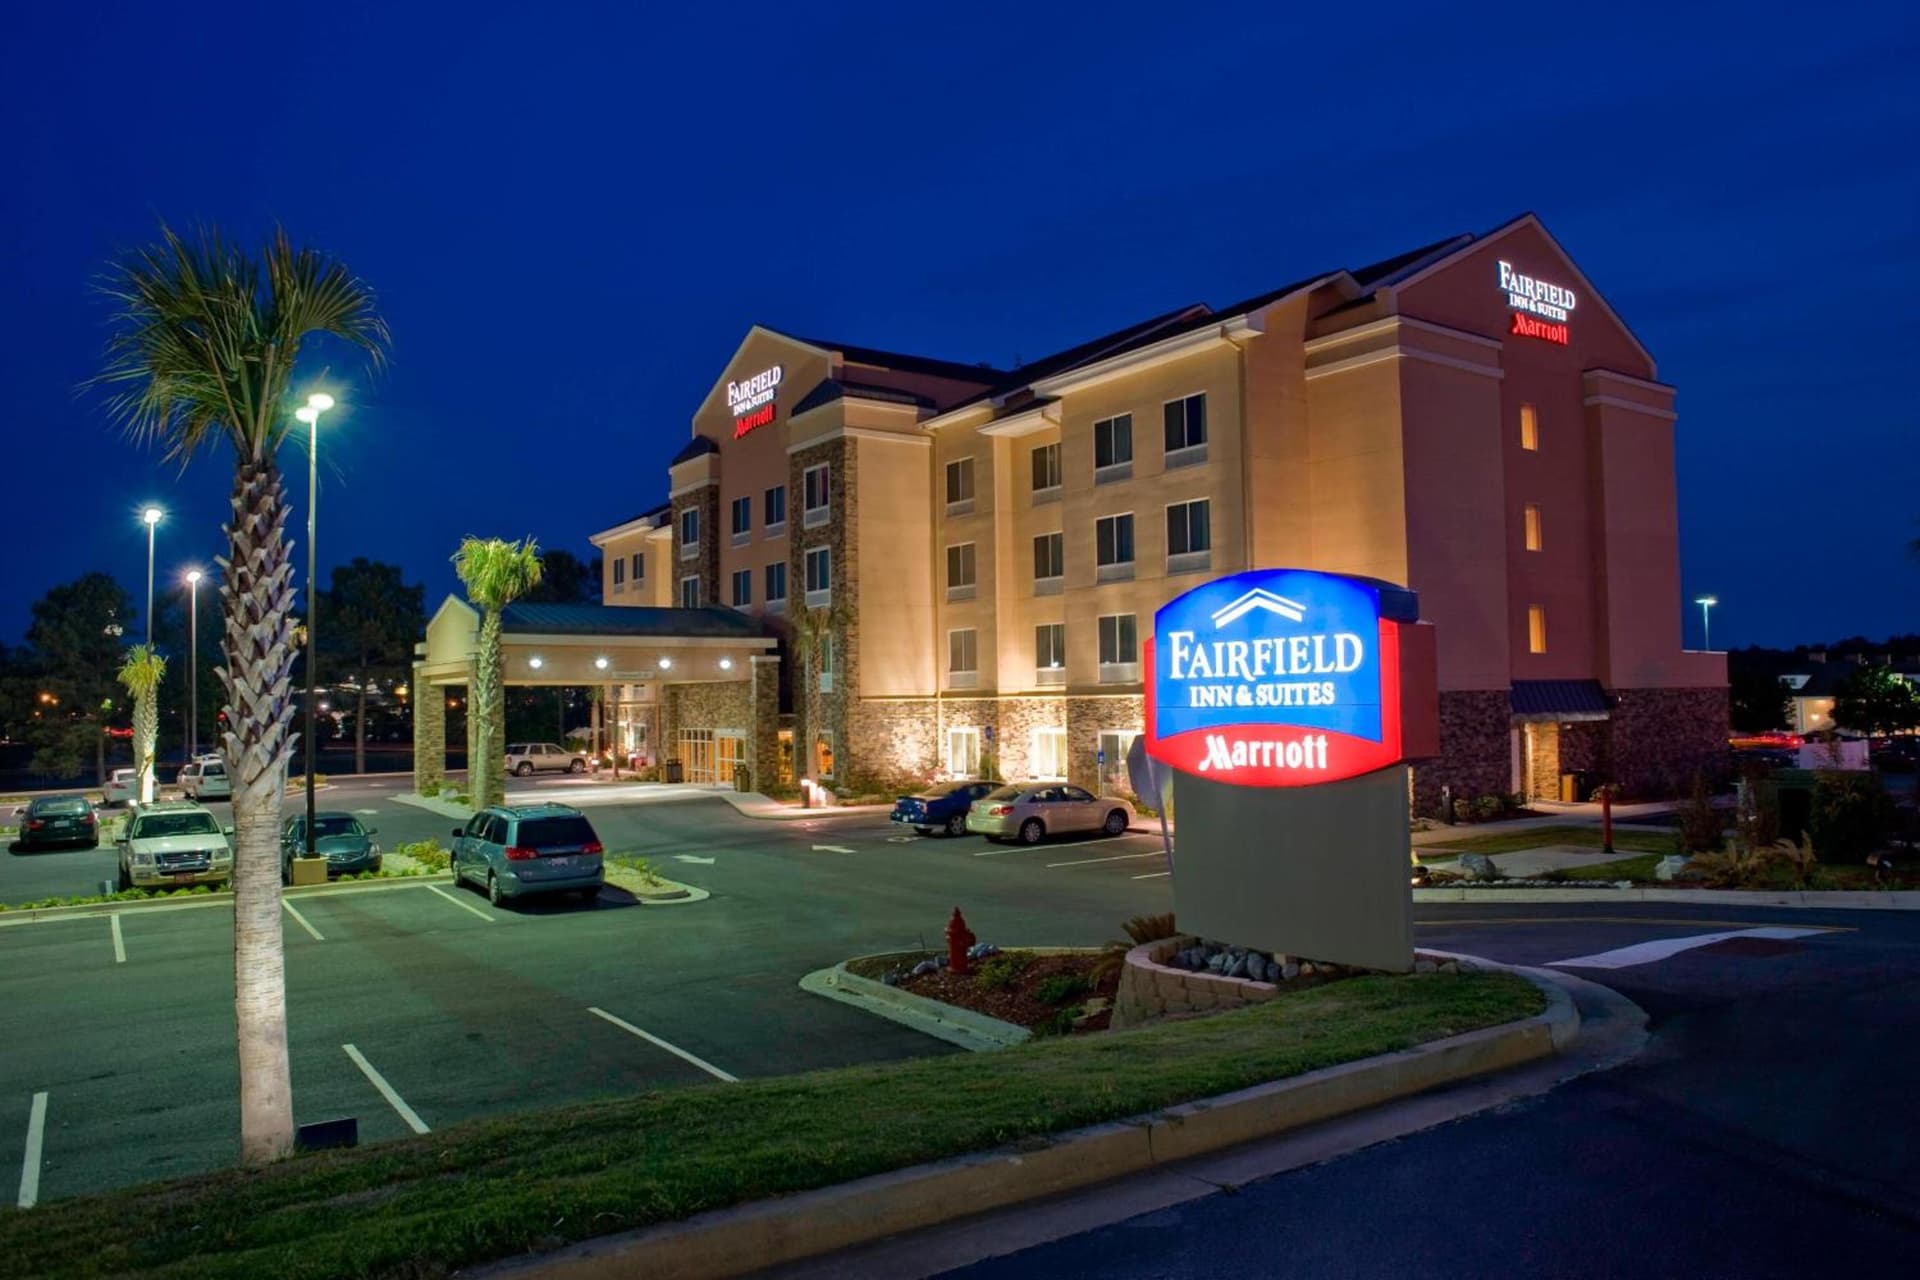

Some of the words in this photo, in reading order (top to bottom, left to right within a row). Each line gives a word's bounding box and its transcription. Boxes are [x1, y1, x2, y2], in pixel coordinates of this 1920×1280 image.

[1498, 260, 1576, 310] FAIRFIELD
[1512, 312, 1568, 344] Marriott
[727, 366, 782, 406] FAIRFIELD
[733, 404, 773, 440] Marriott
[1168, 631, 1364, 682] FAIRFIELD
[1190, 685, 1233, 708] INN
[1256, 682, 1335, 706] SUITES
[1198, 734, 1328, 771] Marriott
